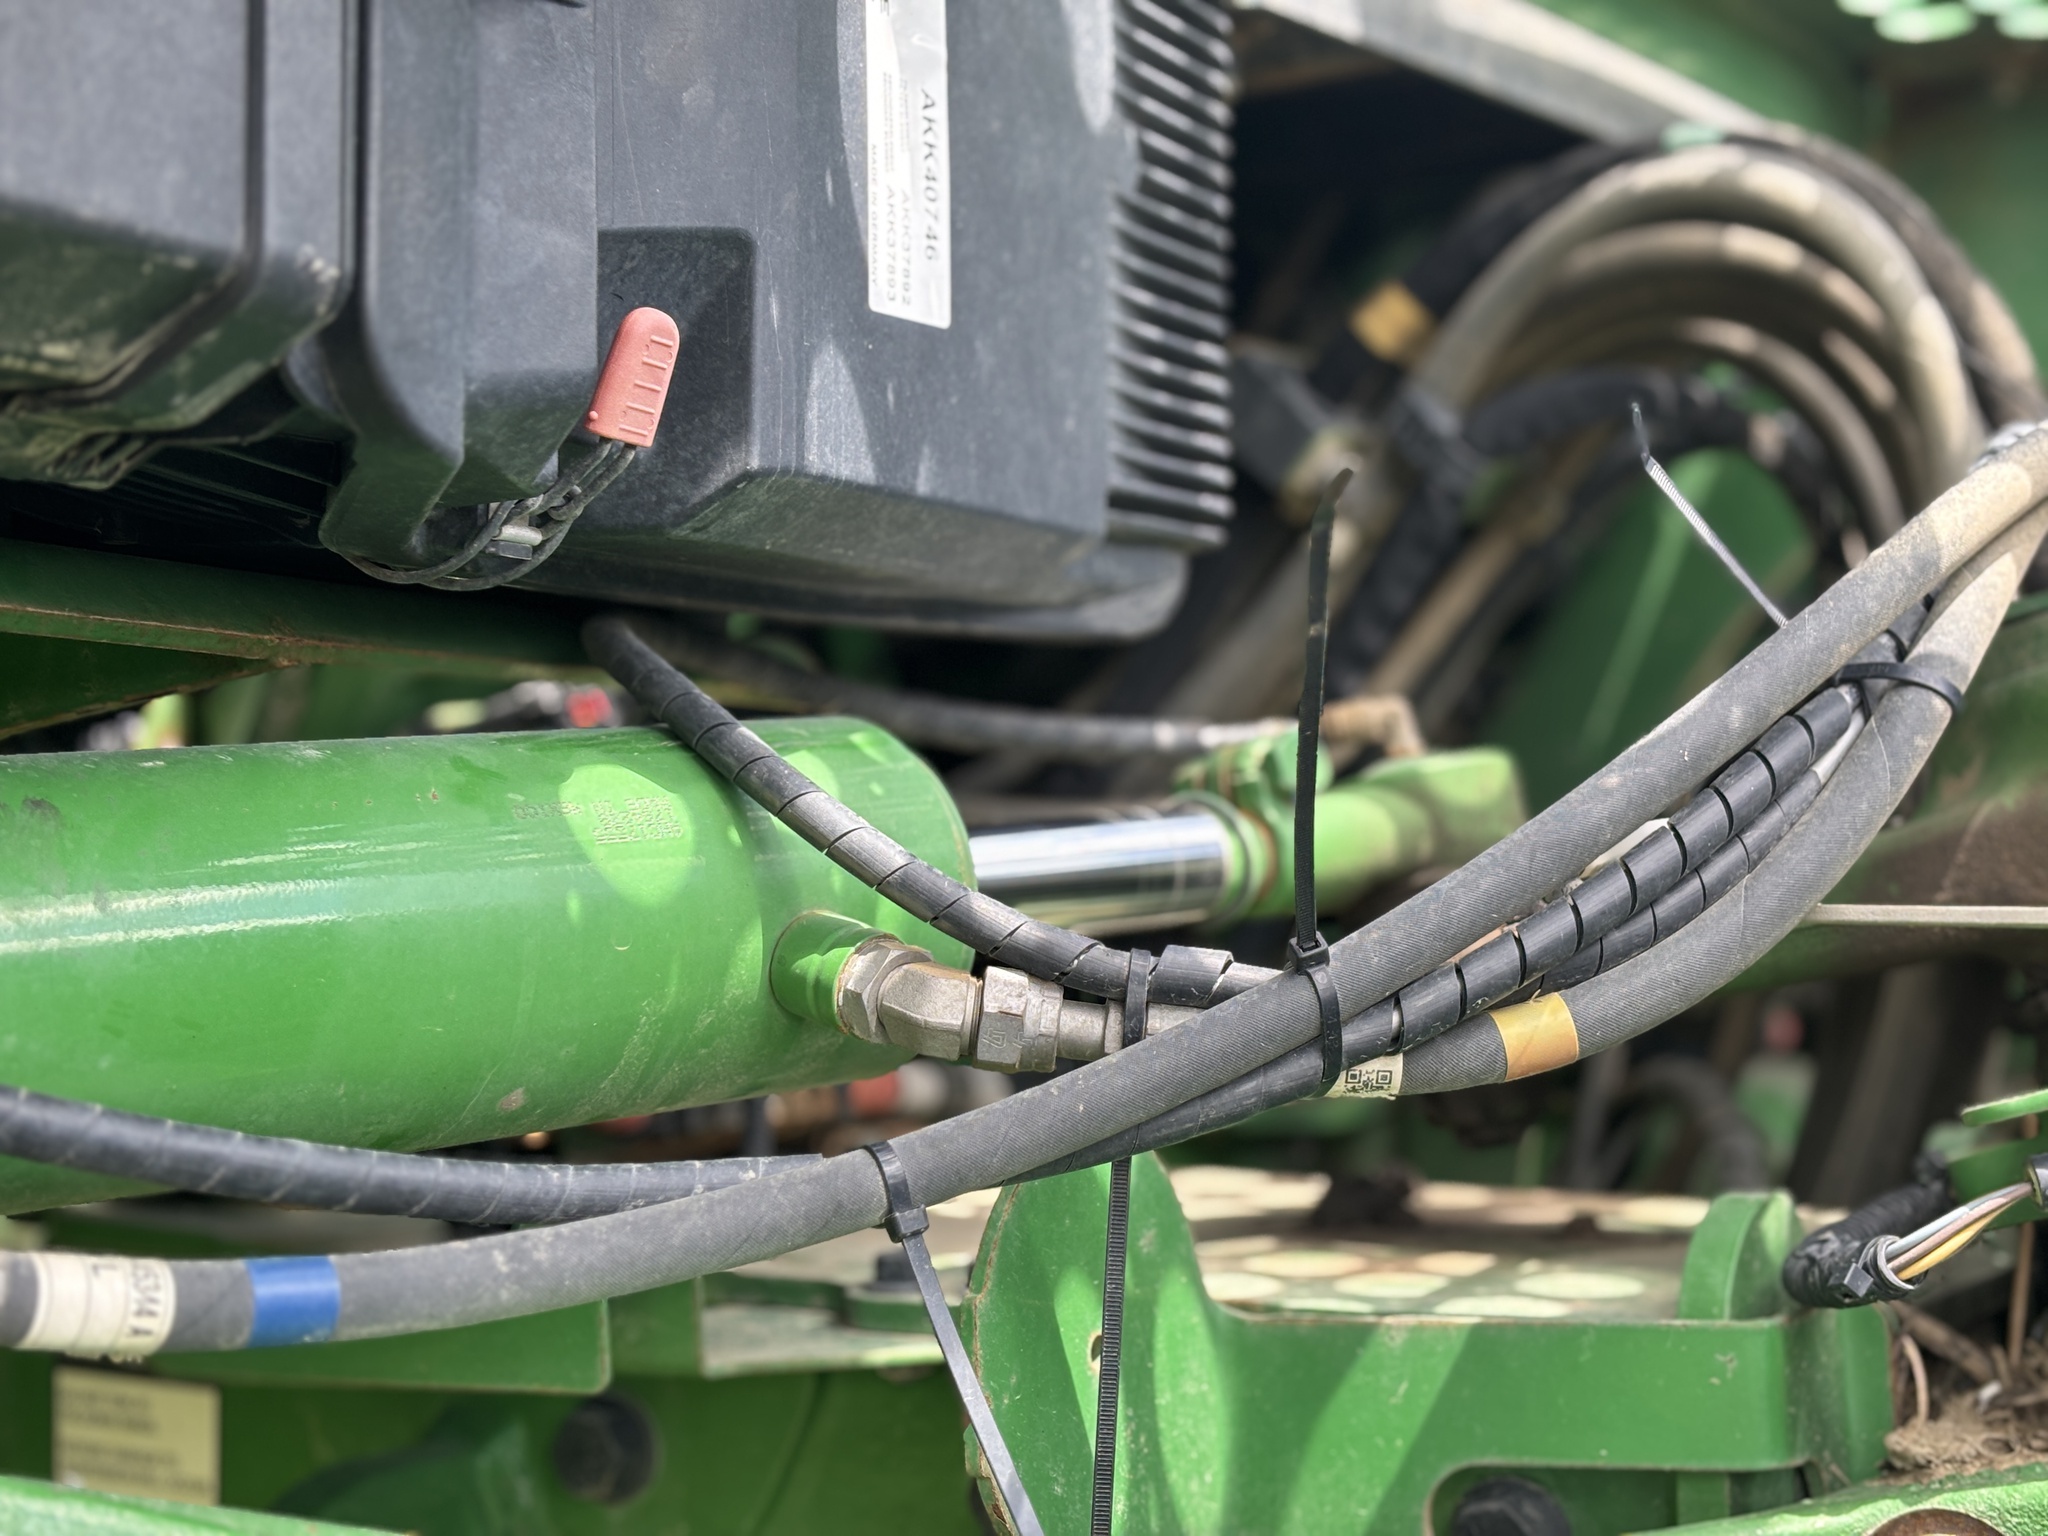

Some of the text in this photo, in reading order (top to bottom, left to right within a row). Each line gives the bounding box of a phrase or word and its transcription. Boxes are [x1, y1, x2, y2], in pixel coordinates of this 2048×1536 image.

[871, 191, 878, 206] IN
[921, 88, 940, 261] AKK40746
[886, 184, 897, 302] AKK37893
[901, 188, 911, 306] AKK37892
